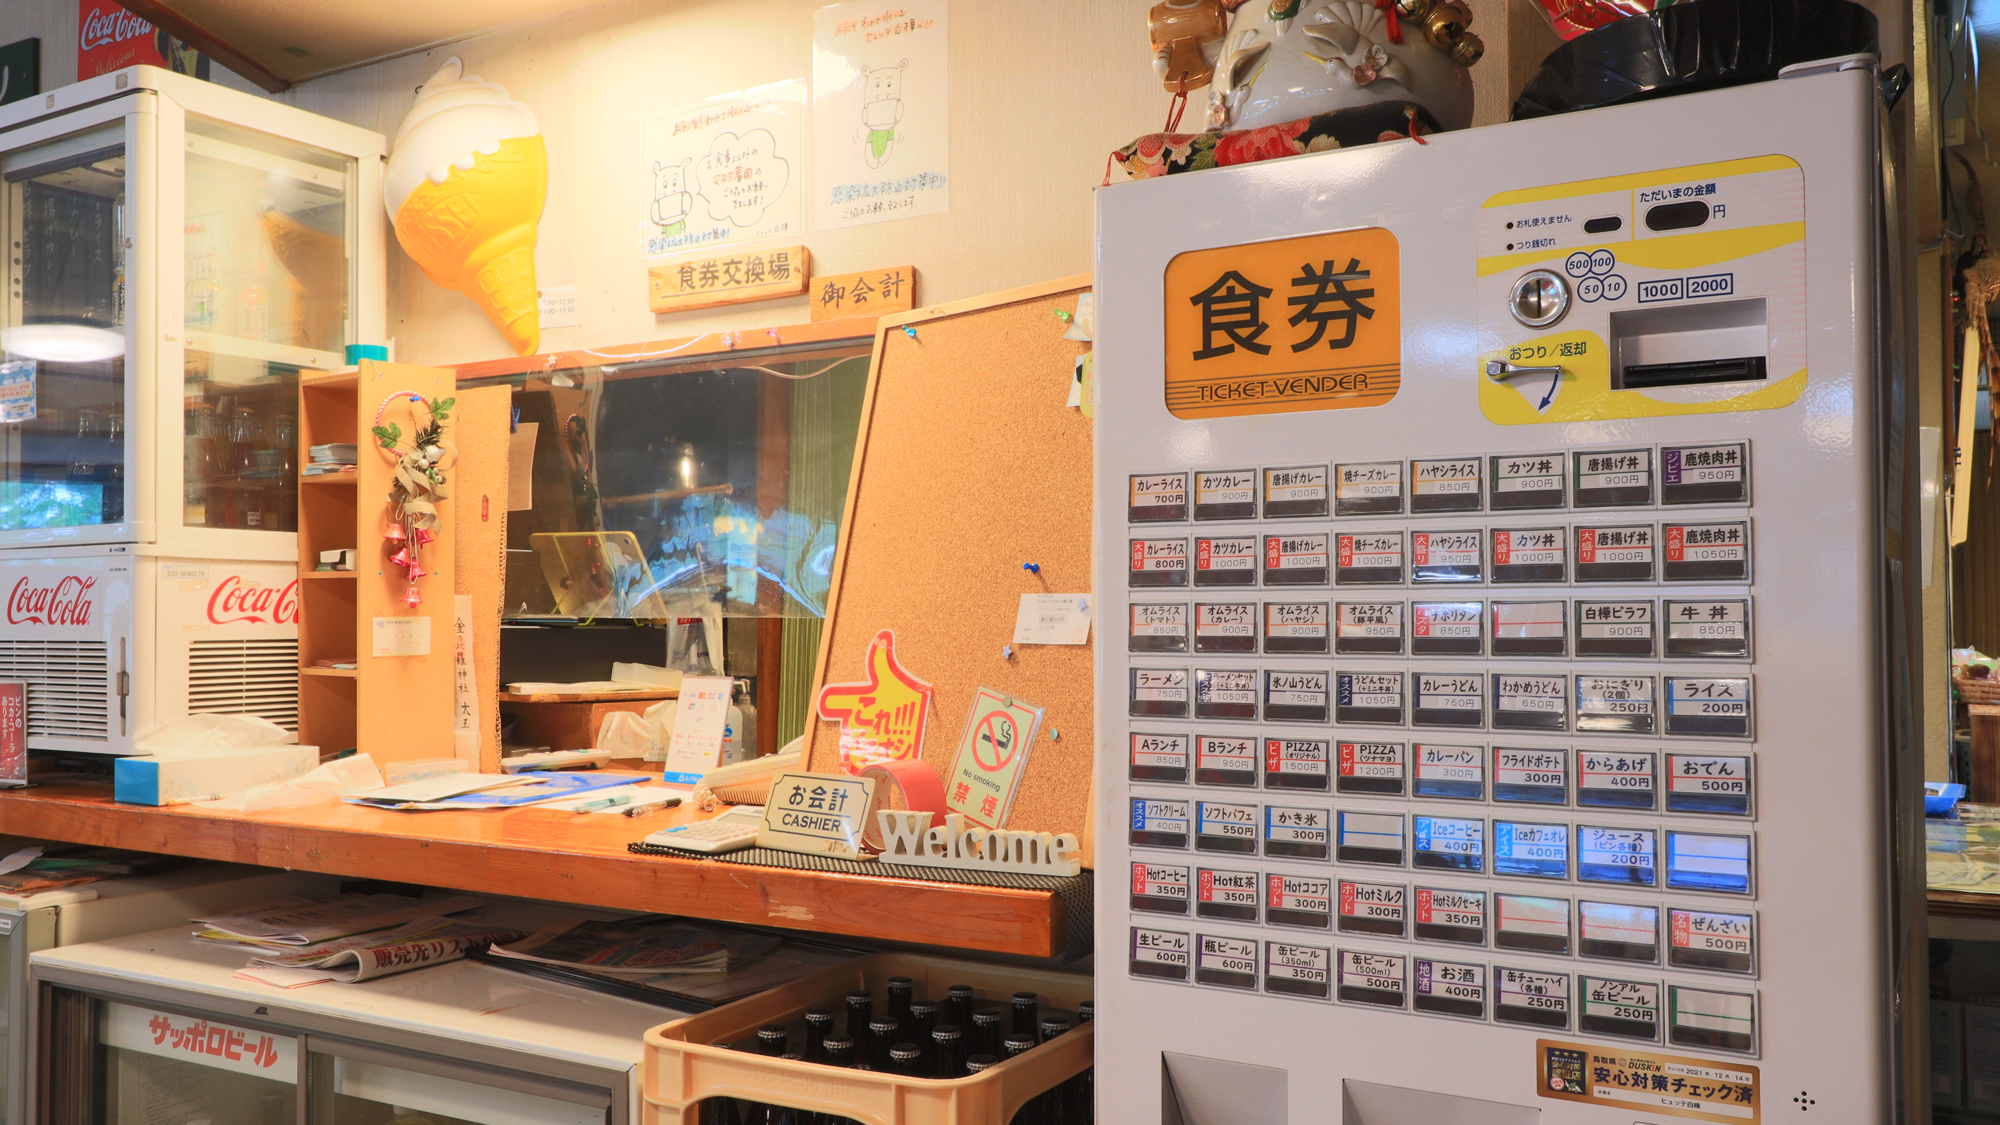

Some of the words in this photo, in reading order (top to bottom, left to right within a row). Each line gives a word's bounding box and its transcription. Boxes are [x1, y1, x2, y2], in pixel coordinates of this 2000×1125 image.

[1639, 182, 1716, 203] ただいまの金額
[1712, 204, 1726, 219] 円
[1515, 213, 1572, 229] お札使えません
[1516, 237, 1556, 250] つり銭切れ
[1568, 259, 1590, 270] 500
[1592, 256, 1612, 268] 100
[677, 252, 791, 291] 食券交換場
[820, 271, 906, 310] 御会計
[1583, 284, 1600, 294] 50
[1607, 281, 1621, 292] 10
[1642, 283, 1679, 298] 1000
[1691, 278, 1728, 294] 2000
[1189, 257, 1376, 362] 食券
[1197, 381, 1269, 401] TICKET
[1272, 373, 1368, 396] VENDER
[1508, 460, 1552, 474] カツ丼
[1588, 456, 1639, 471] 唐揚げ丼
[1666, 452, 1679, 483] ジビエ
[1273, 474, 1322, 486] 唐揚げカレー
[1344, 470, 1397, 482] 焼チーズカレー
[1605, 475, 1639, 485] 900円
[1698, 471, 1734, 480] 950円
[1137, 479, 1183, 491] カレーライス
[1364, 486, 1393, 494] 900円
[1439, 483, 1470, 491] 850円
[1155, 494, 1183, 503] 700円
[1597, 531, 1648, 546] 唐揚げ丼
[1686, 528, 1740, 543] 鹿焼肉丼
[1213, 543, 1252, 554] カツカレー
[1355, 538, 1399, 551] 焼チーズカレー
[1431, 536, 1477, 549] ハヤシライス
[1581, 531, 1593, 560] 大盛り
[1147, 543, 1184, 556] カレーライス
[1200, 542, 1209, 568] 大盛り
[1341, 538, 1351, 564] 大盛り
[1694, 549, 1737, 559] 1050円
[1215, 559, 1247, 568] 1000円
[1287, 556, 1320, 565] 1000円
[1441, 555, 1471, 563] 950円
[1515, 553, 1554, 561] 1000円
[7, 575, 98, 626] Coca-Cola
[1208, 606, 1248, 616] オムライス
[1277, 606, 1319, 616] オムライス
[1292, 627, 1319, 635] 900円
[1366, 627, 1394, 635] 950円
[1440, 627, 1470, 635] 850円
[1609, 627, 1643, 635] 900円
[1699, 626, 1735, 635] 850円
[1139, 674, 1184, 685] ラーメン
[1273, 677, 1322, 689] 氷ノ山うどん
[1423, 679, 1478, 692] カレーうどん
[1503, 681, 1560, 695] わかめうどん
[1684, 683, 1733, 698] ライス
[1217, 693, 1248, 701] 1050円
[1291, 695, 1317, 703] 750円
[1360, 696, 1395, 704] 1050円
[1602, 691, 1630, 699] (2個)
[1522, 700, 1554, 709] 650円
[1702, 704, 1743, 713] 200円
[1142, 739, 1179, 751] Aランチ
[1209, 742, 1247, 754] Bランチ
[1360, 745, 1396, 755] PIZZA
[1223, 760, 1248, 768] 950円
[1342, 746, 1352, 773] ピザ
[1427, 751, 1474, 764] カレーパン
[1285, 762, 1318, 771] 1500円
[1587, 758, 1647, 771] からあげ
[1683, 761, 1734, 776] おでん
[1443, 769, 1473, 778] 300円
[1524, 773, 1560, 784] 300円
[963, 768, 973, 778] No
[973, 774, 1001, 793] smoking
[1702, 781, 1742, 791] 500円
[789, 785, 848, 812] お会計
[953, 781, 999, 819] 禁煙
[1134, 802, 1144, 828] オススメ
[1279, 812, 1318, 826] かき氷
[782, 813, 841, 832] CASHIER
[1433, 822, 1480, 836] Iceコーヒー
[1223, 826, 1253, 836] 550円
[877, 809, 1080, 867] Welcome
[1499, 825, 1510, 855] アイス
[1445, 841, 1479, 852] 400円
[1528, 848, 1563, 858] 400円
[1612, 854, 1650, 865] 200円
[1135, 866, 1144, 891] ホット
[1147, 868, 1186, 882] Hotコーヒー
[1214, 875, 1255, 888] Hot紅茶
[1224, 892, 1254, 902] 350円
[1271, 878, 1281, 905] ホット
[1356, 887, 1402, 903] Hotミルク
[1295, 899, 1326, 910] 300円
[1419, 891, 1430, 920] ホット
[1445, 914, 1480, 925] 350円
[1692, 917, 1746, 934] ぜんざい
[1139, 934, 1184, 949] 生ビール
[1157, 952, 1185, 963] 600円
[1278, 946, 1320, 958] 缶ビール
[1223, 960, 1252, 971] 600円
[1281, 956, 1314, 967] (350ml)
[1352, 954, 1396, 968] 缶ビール
[1367, 978, 1400, 990] 500円
[1419, 963, 1430, 992] 地酒
[1507, 971, 1562, 986] 缶チューハイ
[1445, 986, 1480, 999] 400円
[1600, 981, 1640, 994] ノンアル
[1592, 990, 1650, 1006] 缶ビール
[149, 1014, 278, 1068] サッポロビール
[1593, 1056, 1616, 1065] 鳥取県
[1594, 1066, 1753, 1104] 安心対策チェック済
